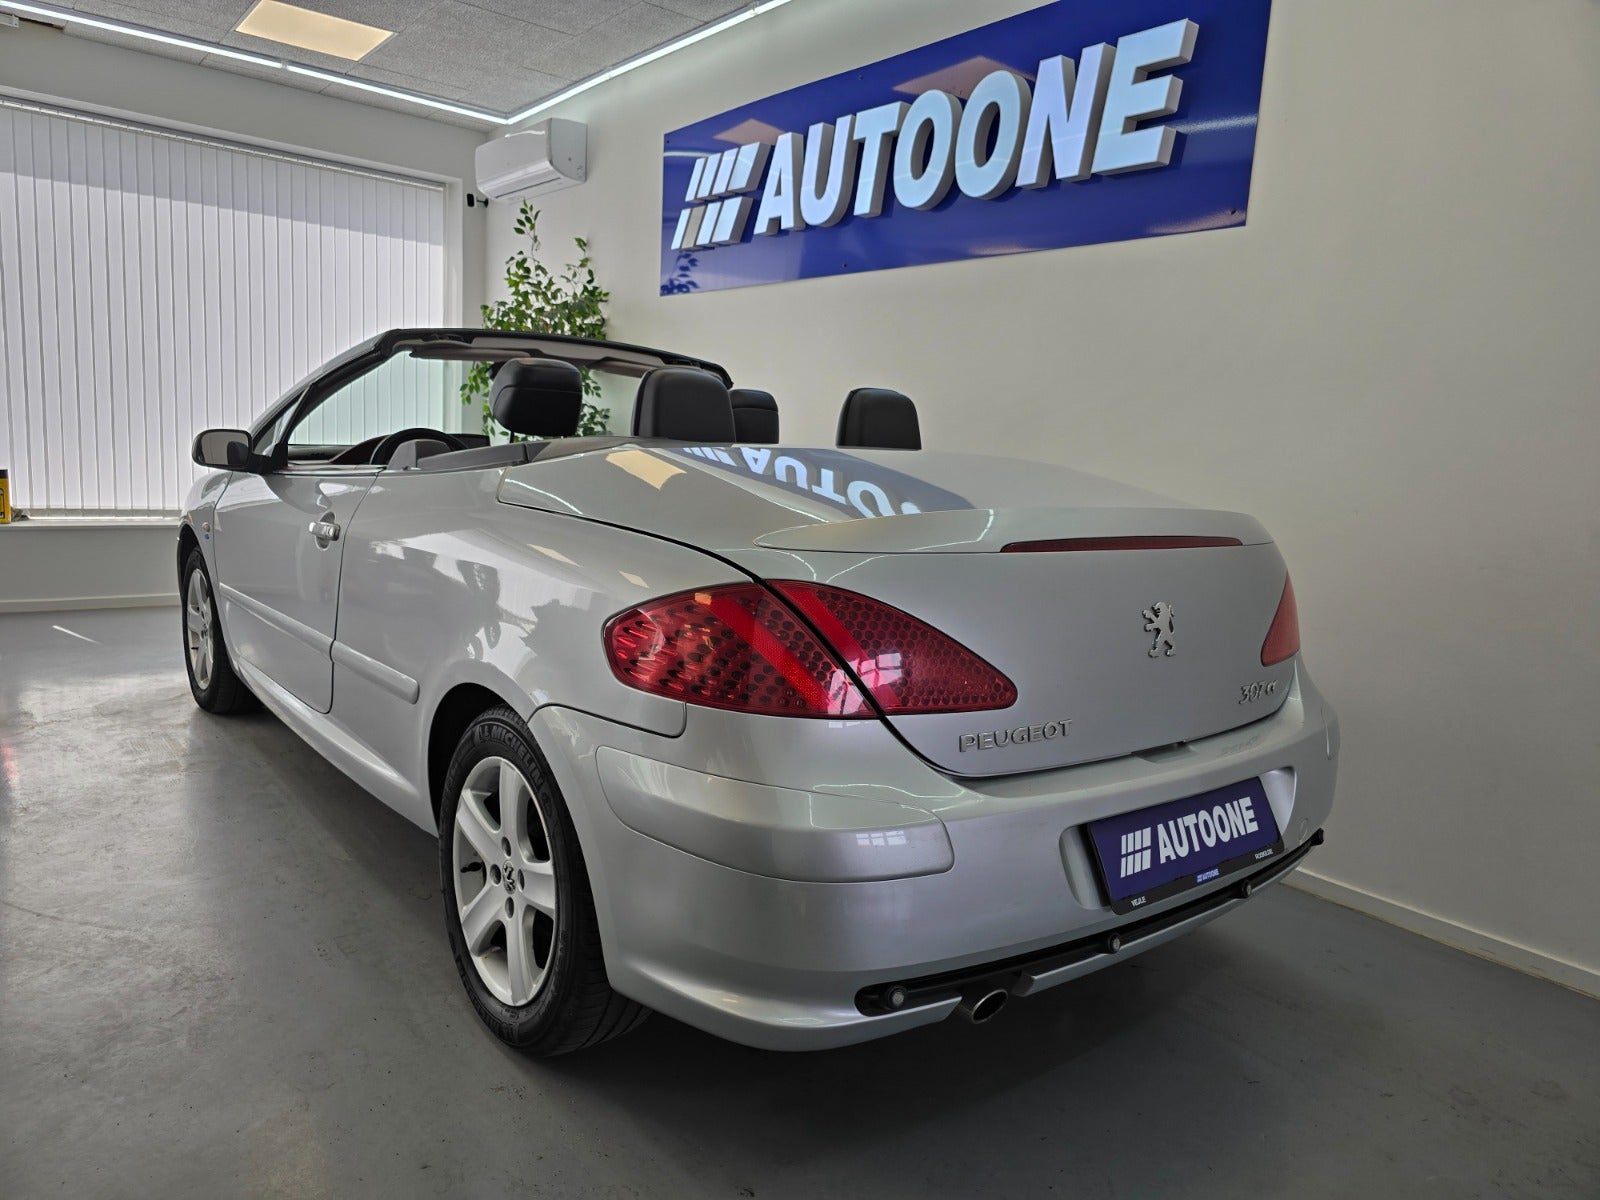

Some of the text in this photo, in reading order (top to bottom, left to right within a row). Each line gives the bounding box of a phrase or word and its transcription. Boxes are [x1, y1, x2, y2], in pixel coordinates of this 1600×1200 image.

[753, 18, 1199, 237] AUTOONE
[490, 724, 545, 788] MICHELIN
[959, 719, 1073, 752] PEUGEOT
[1157, 796, 1259, 865] AUTOONE
